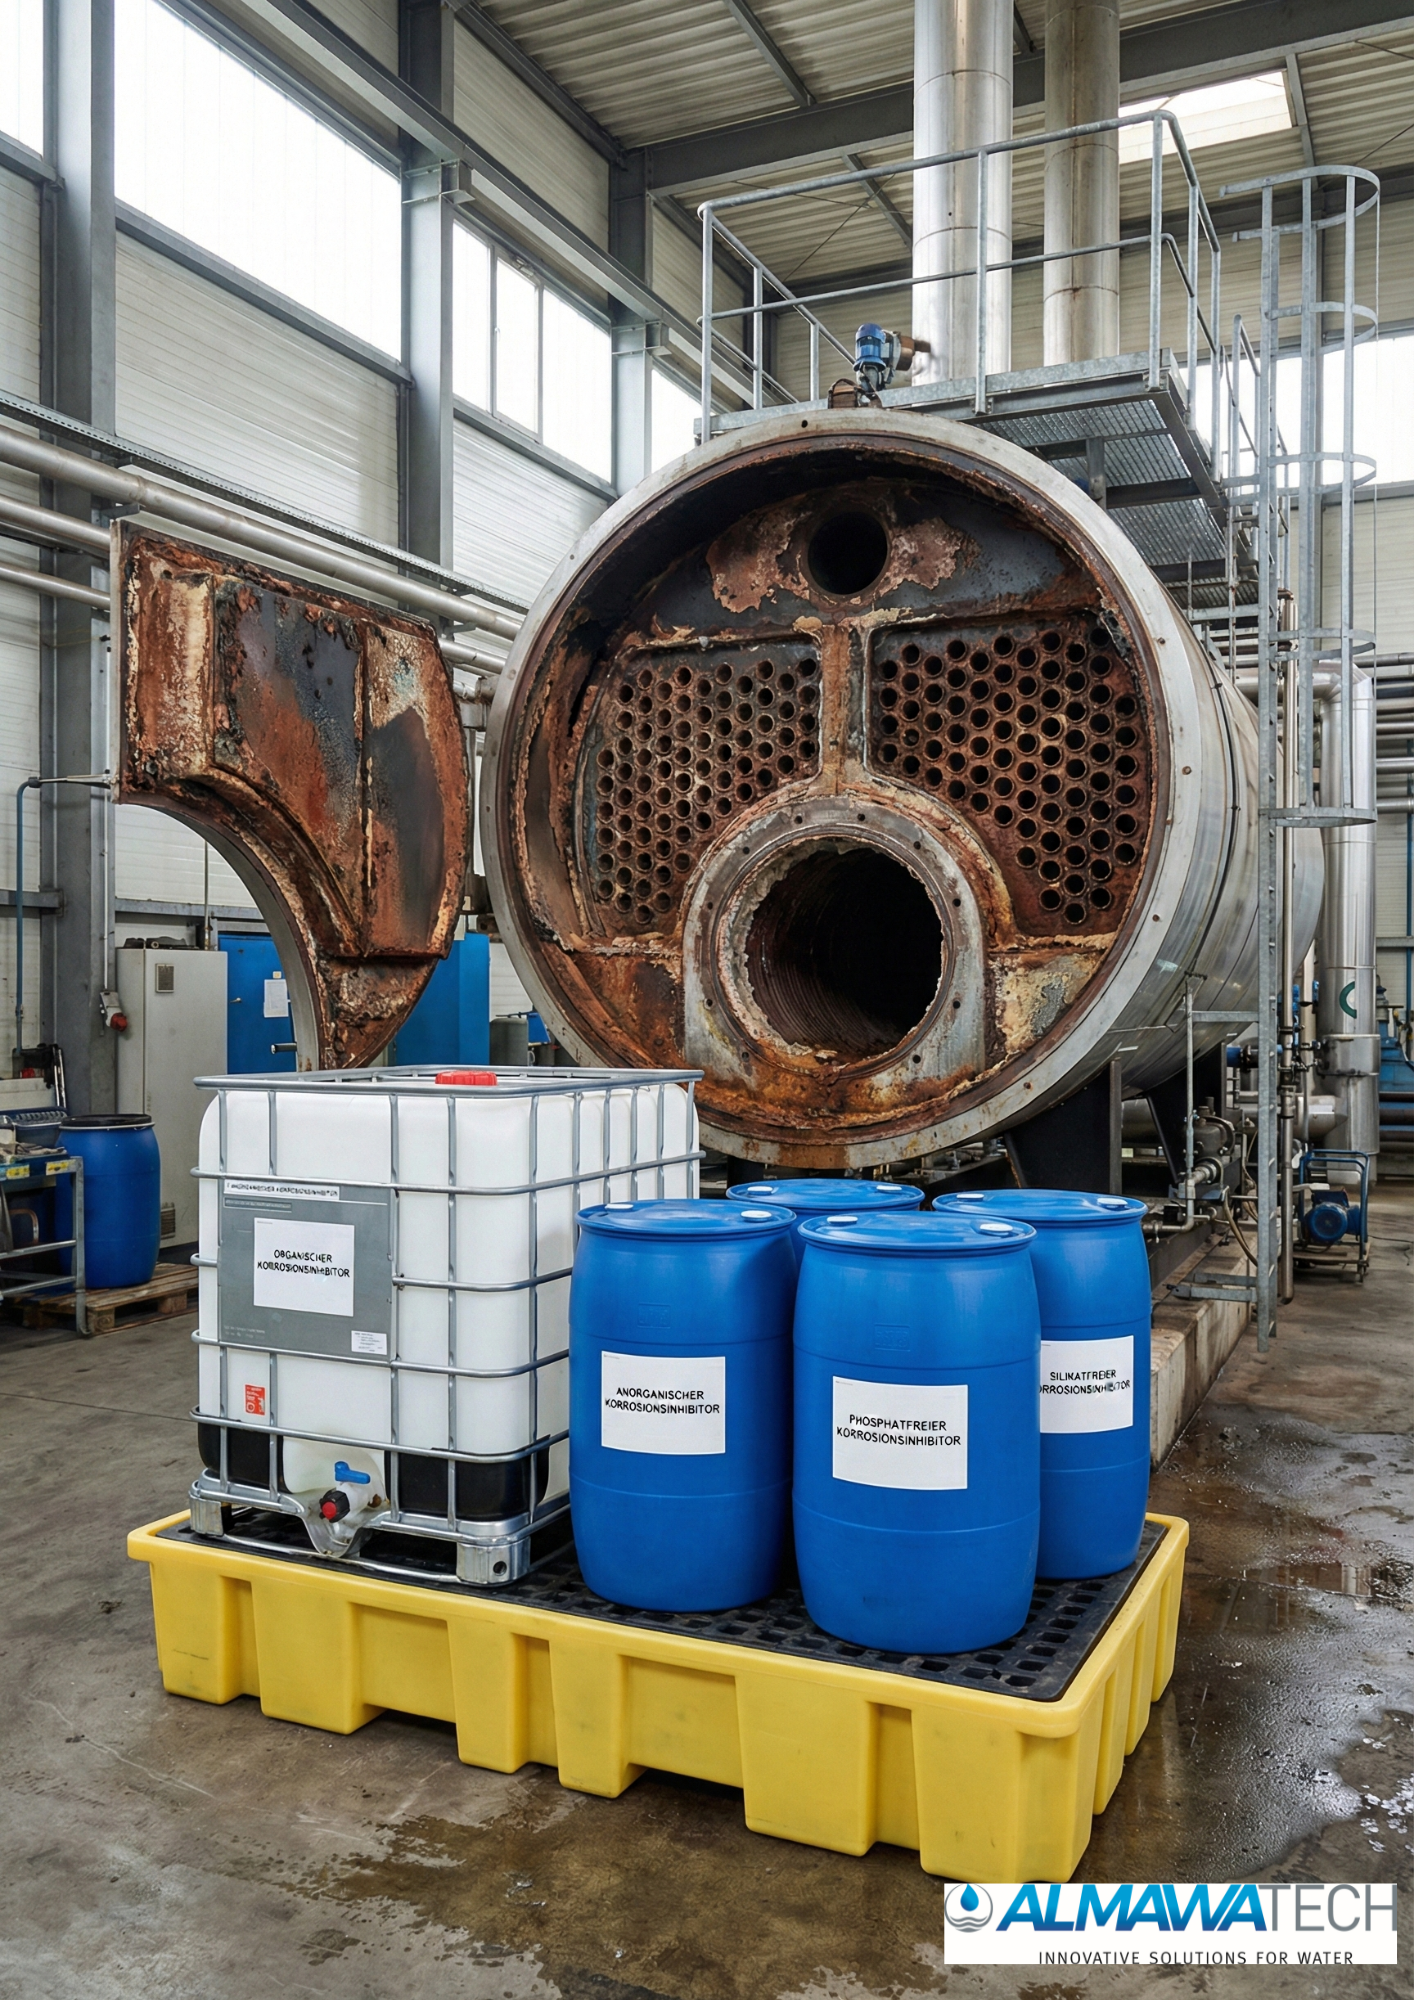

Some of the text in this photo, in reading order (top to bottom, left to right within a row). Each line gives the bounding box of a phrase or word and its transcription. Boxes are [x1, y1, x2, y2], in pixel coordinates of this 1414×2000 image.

[615, 1387, 705, 1400] ANORGANISCHER
[604, 1398, 720, 1414] KORROSIONSINHIBITOR
[849, 1413, 947, 1432] PHOSPHATFREIER
[836, 1426, 961, 1446] KORROSIONSINHIBITOR
